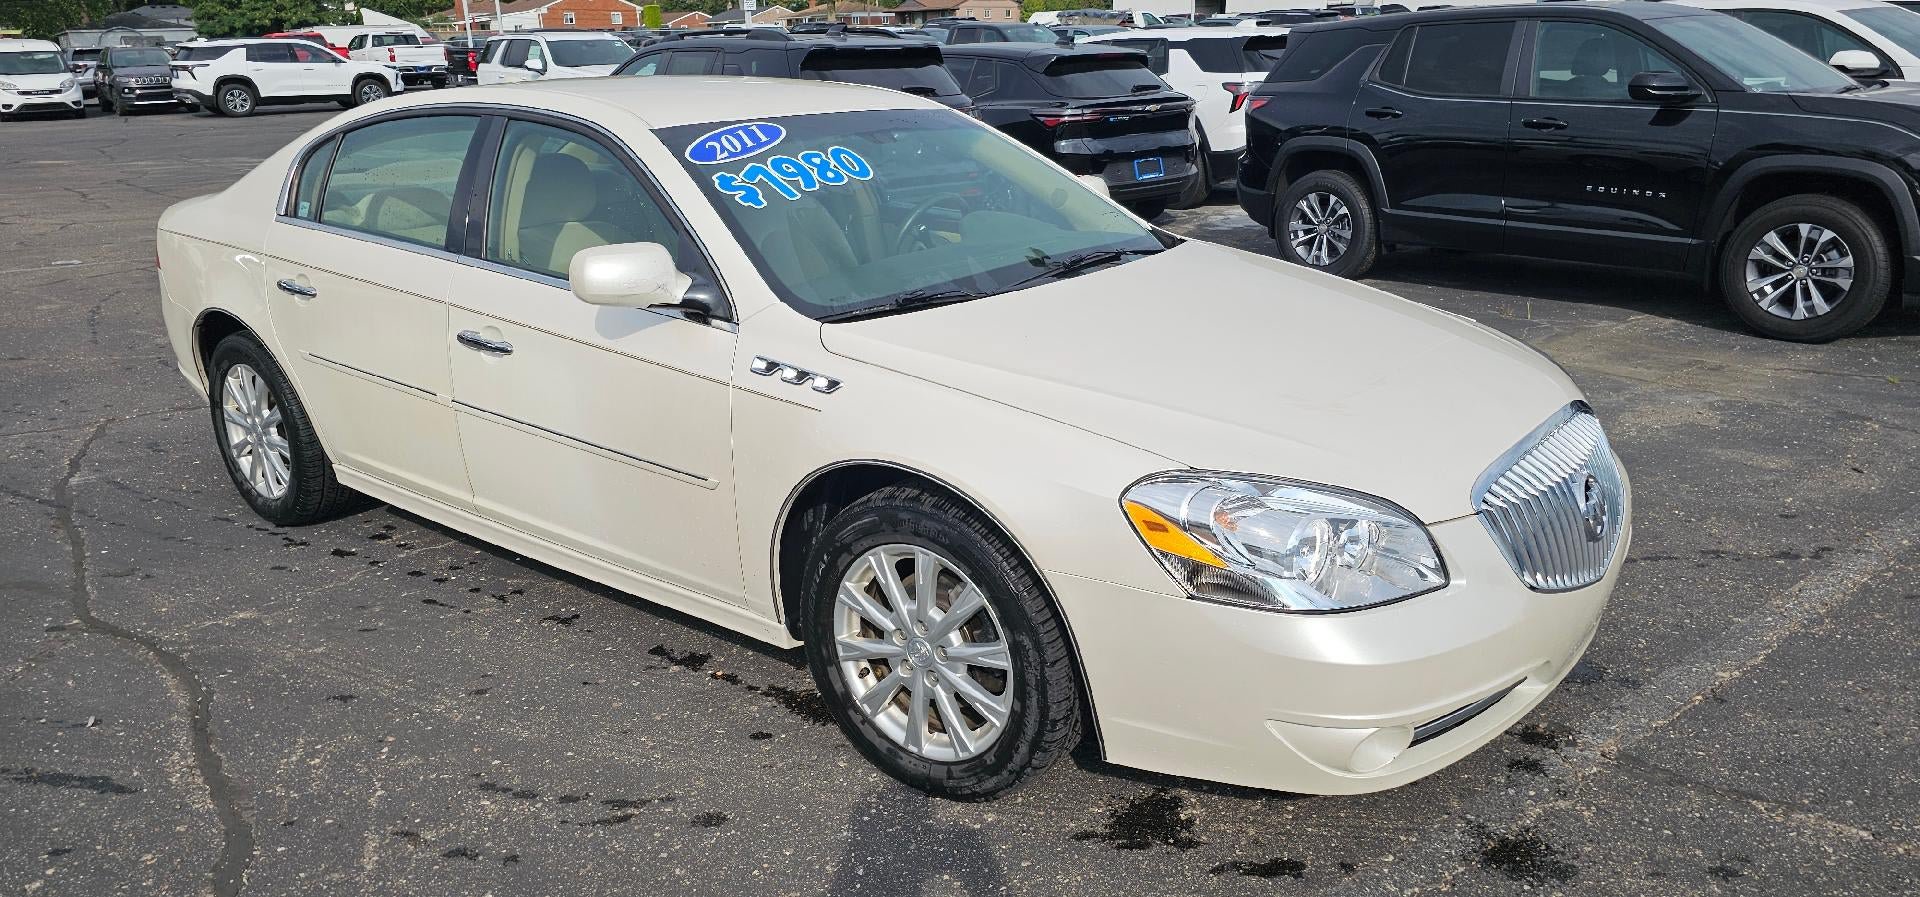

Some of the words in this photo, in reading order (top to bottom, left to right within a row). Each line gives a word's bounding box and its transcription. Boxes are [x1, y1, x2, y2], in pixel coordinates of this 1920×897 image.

[705, 125, 770, 161] 2011
[712, 146, 874, 209] $7980
[1585, 185, 1667, 198] EQUINOX
